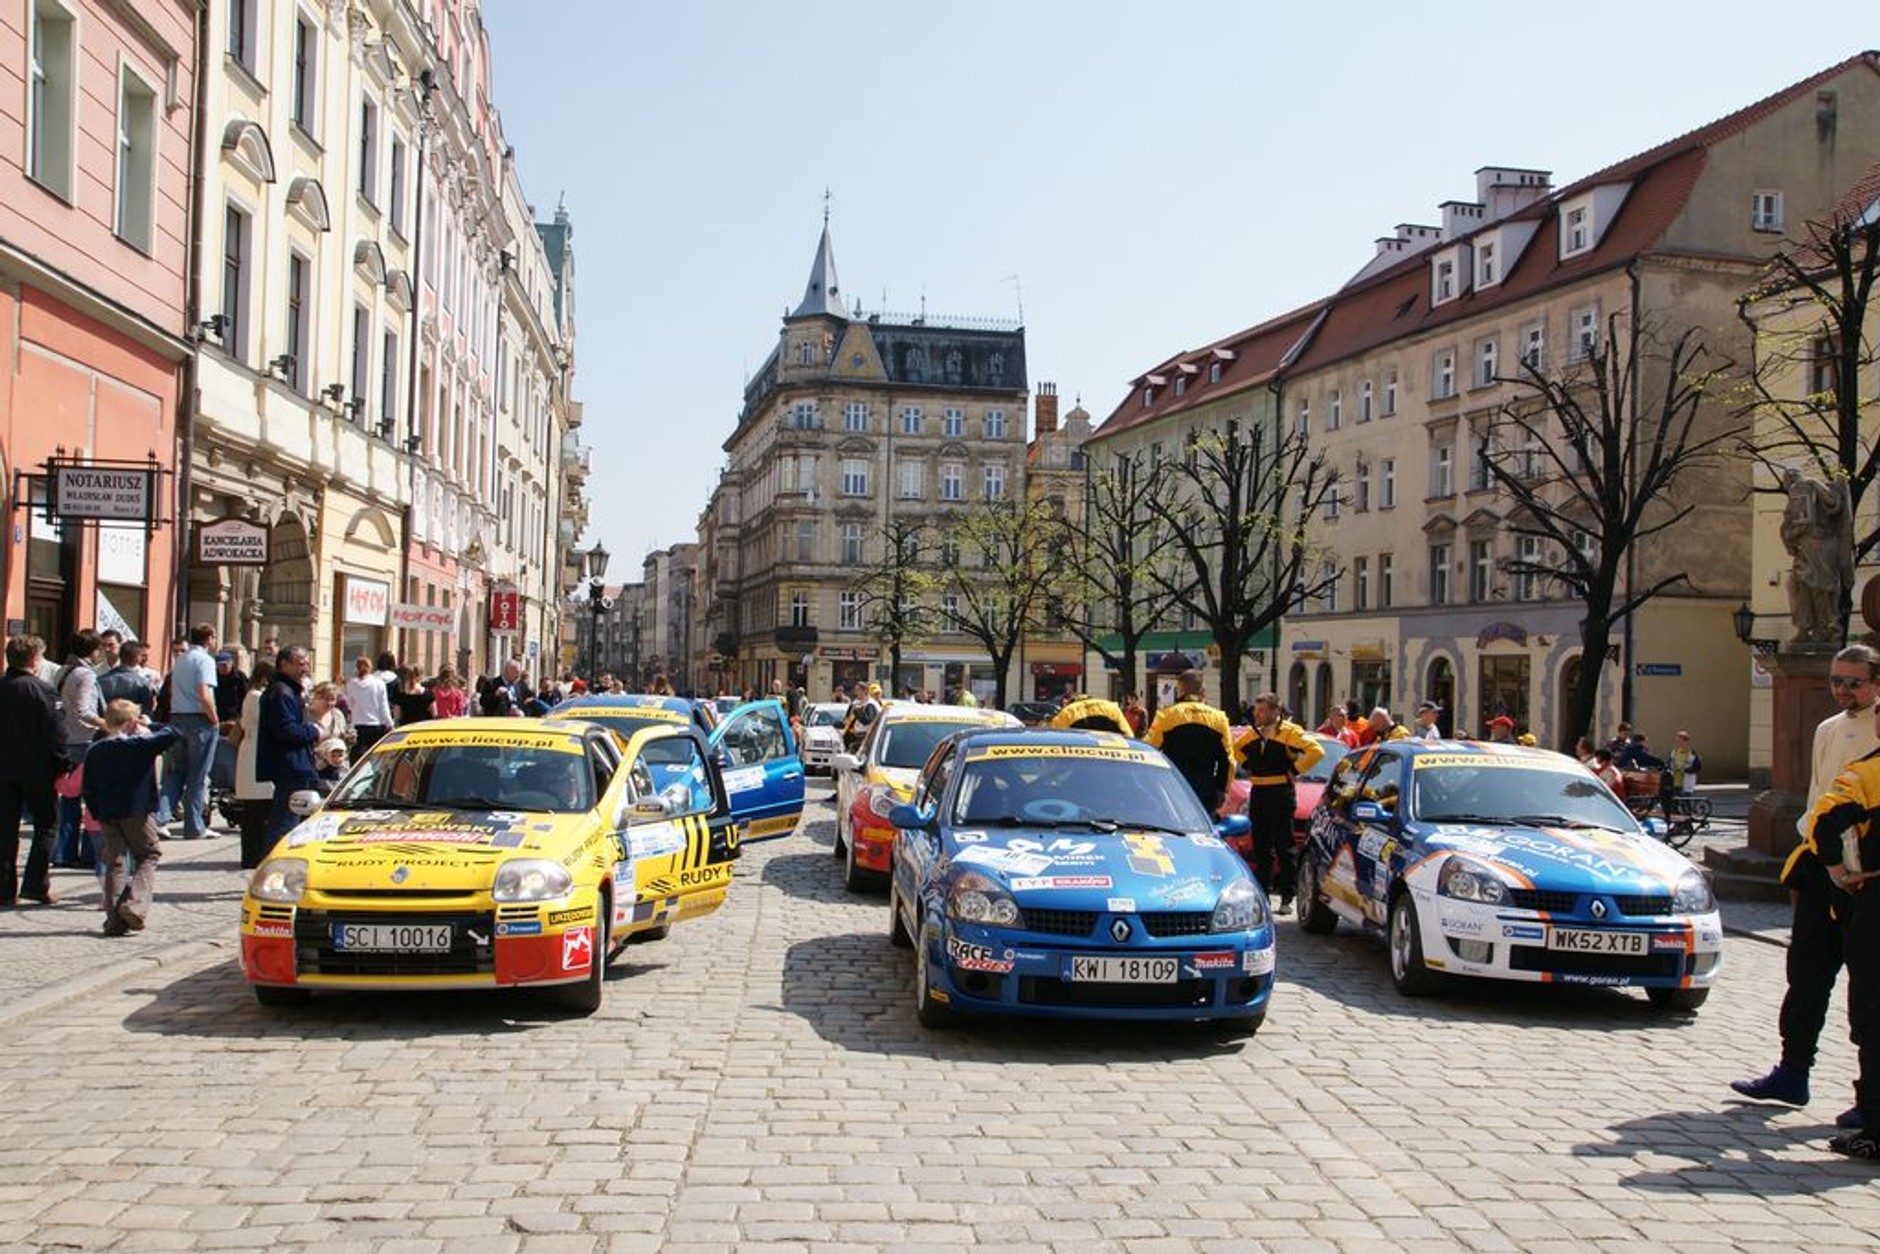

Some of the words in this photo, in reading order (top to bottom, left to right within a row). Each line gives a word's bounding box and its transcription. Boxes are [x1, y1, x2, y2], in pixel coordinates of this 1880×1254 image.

[65, 473, 142, 489] NOTARIUSZ
[203, 535, 264, 547] KANCELARIA
[203, 548, 265, 559] ADWOKACKA
[405, 734, 554, 748] www.cliocup.pl
[991, 745, 1146, 762] www.cliocup.pl
[336, 859, 387, 868] RUDY
[393, 858, 471, 868] PROJECT
[1504, 835, 1629, 877] GORAN
[681, 867, 722, 887] RUDY
[345, 926, 379, 948] SCI
[390, 927, 449, 947] 10016
[1555, 931, 1602, 950] WK52
[1608, 934, 1643, 952] XTB
[949, 936, 992, 961] RACE
[1074, 957, 1107, 979] KWI
[1120, 960, 1176, 980] 18109
[1564, 974, 1631, 985] www.goran.pl
